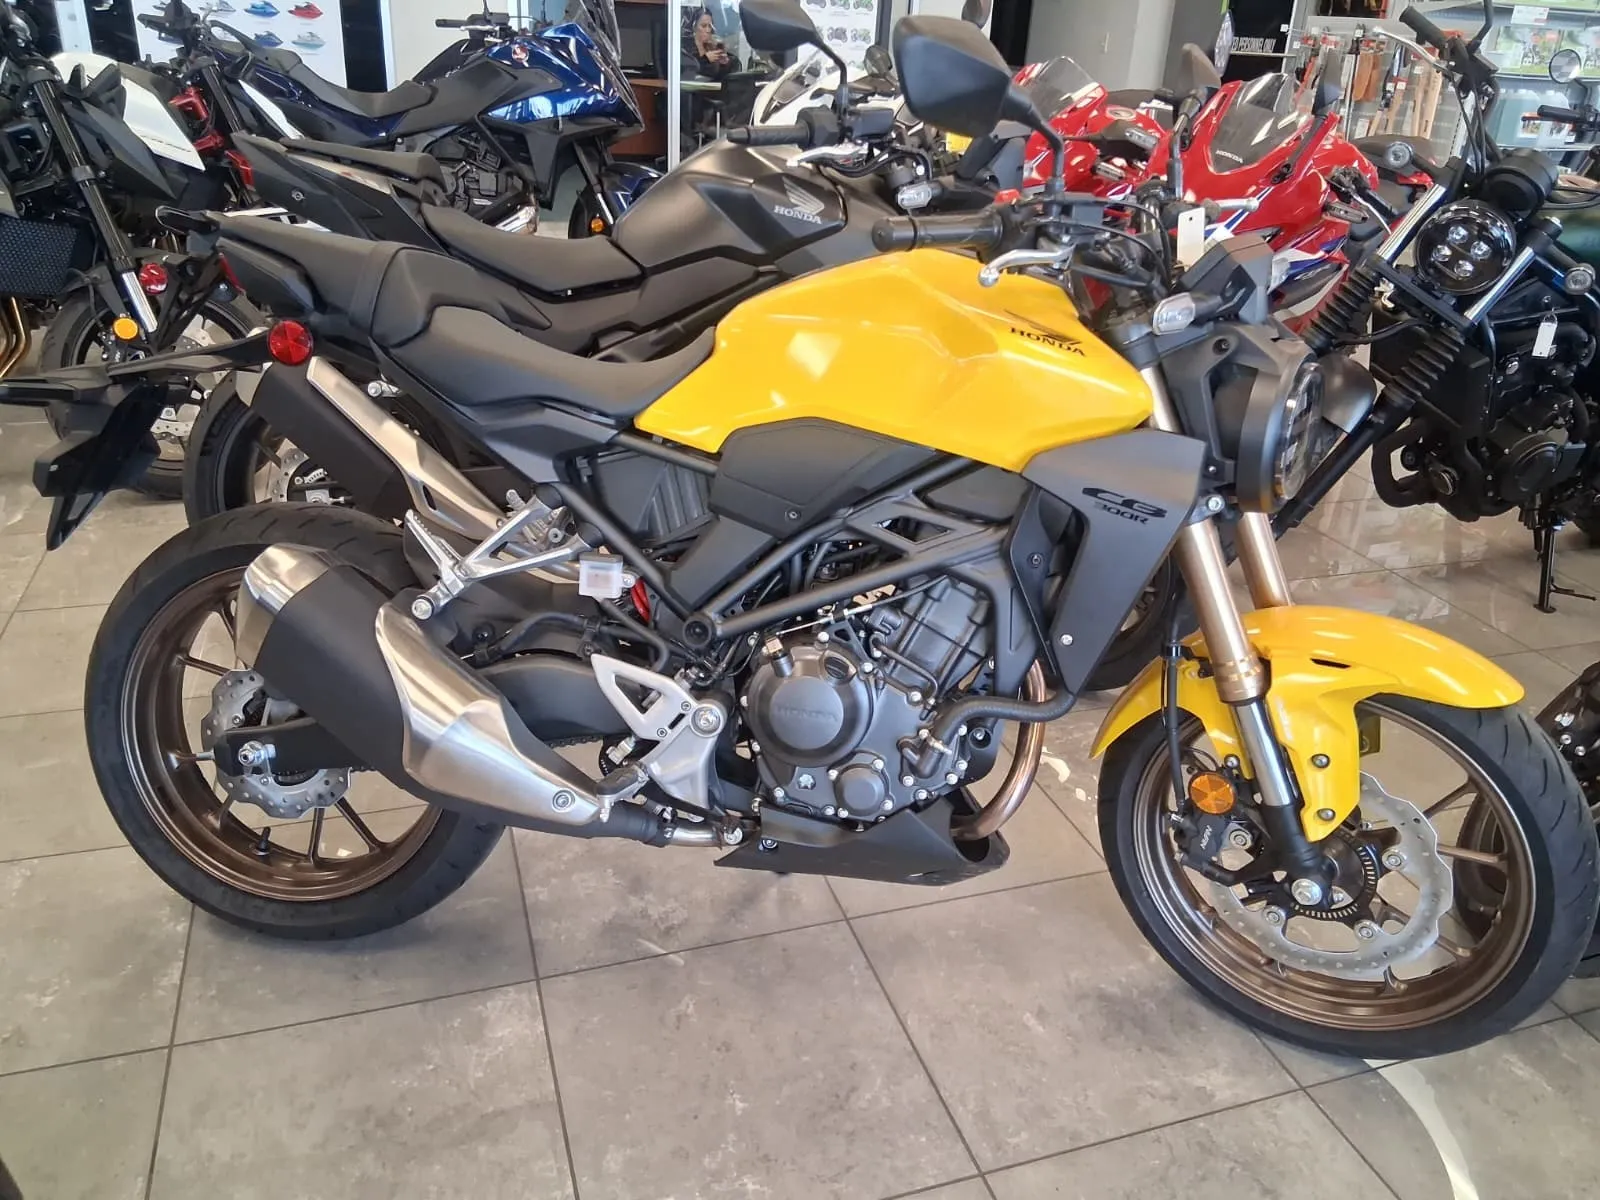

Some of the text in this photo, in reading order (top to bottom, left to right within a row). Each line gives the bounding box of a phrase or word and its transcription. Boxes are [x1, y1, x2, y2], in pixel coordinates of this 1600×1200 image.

[1263, 38, 1276, 53] ONLY
[773, 205, 822, 224] HONDA
[1009, 327, 1086, 357] HONDA
[1082, 487, 1168, 518] CB
[1093, 501, 1148, 525] 300R
